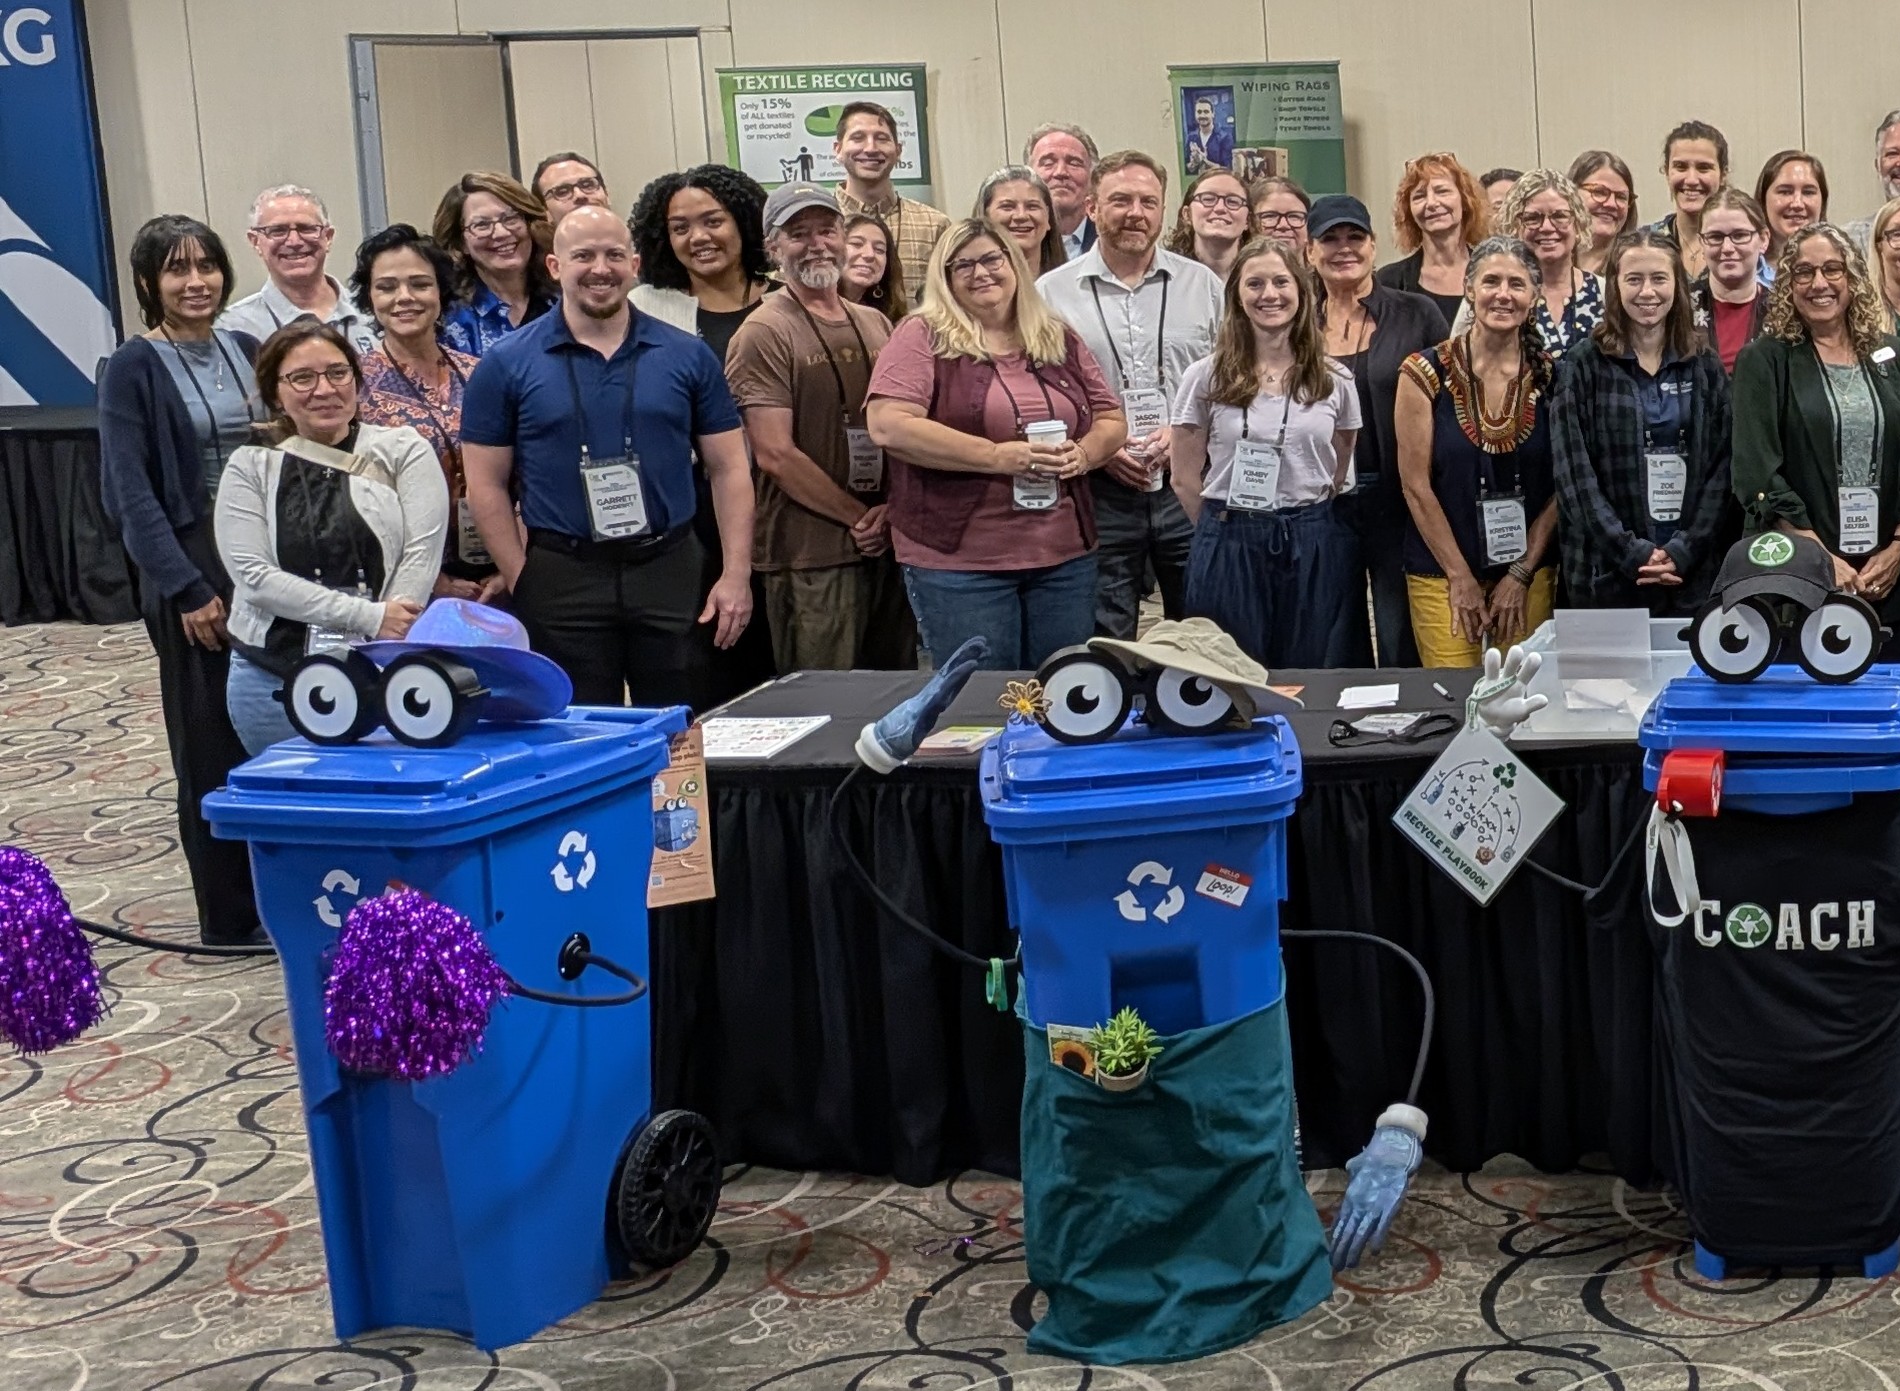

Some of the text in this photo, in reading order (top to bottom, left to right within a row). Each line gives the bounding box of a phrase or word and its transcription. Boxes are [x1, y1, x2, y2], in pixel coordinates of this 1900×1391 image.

[733, 72, 914, 90] TEXTILE RECYCLING
[740, 97, 792, 111] Only 15%
[740, 112, 749, 120] of
[750, 112, 766, 120] ALL
[743, 121, 792, 132] get donated
[1134, 413, 1160, 422] JASON
[1243, 468, 1269, 479] KIMBY
[596, 493, 638, 507] GARRETT
[1846, 515, 1868, 523] ELISA
[1489, 524, 1523, 535] KRISTINA
[1403, 808, 1490, 891] RECYCLE PLAYBOOK
[1219, 866, 1241, 879] HELLO
[1206, 879, 1240, 898] Loop!
[1694, 899, 1876, 951] COACH
